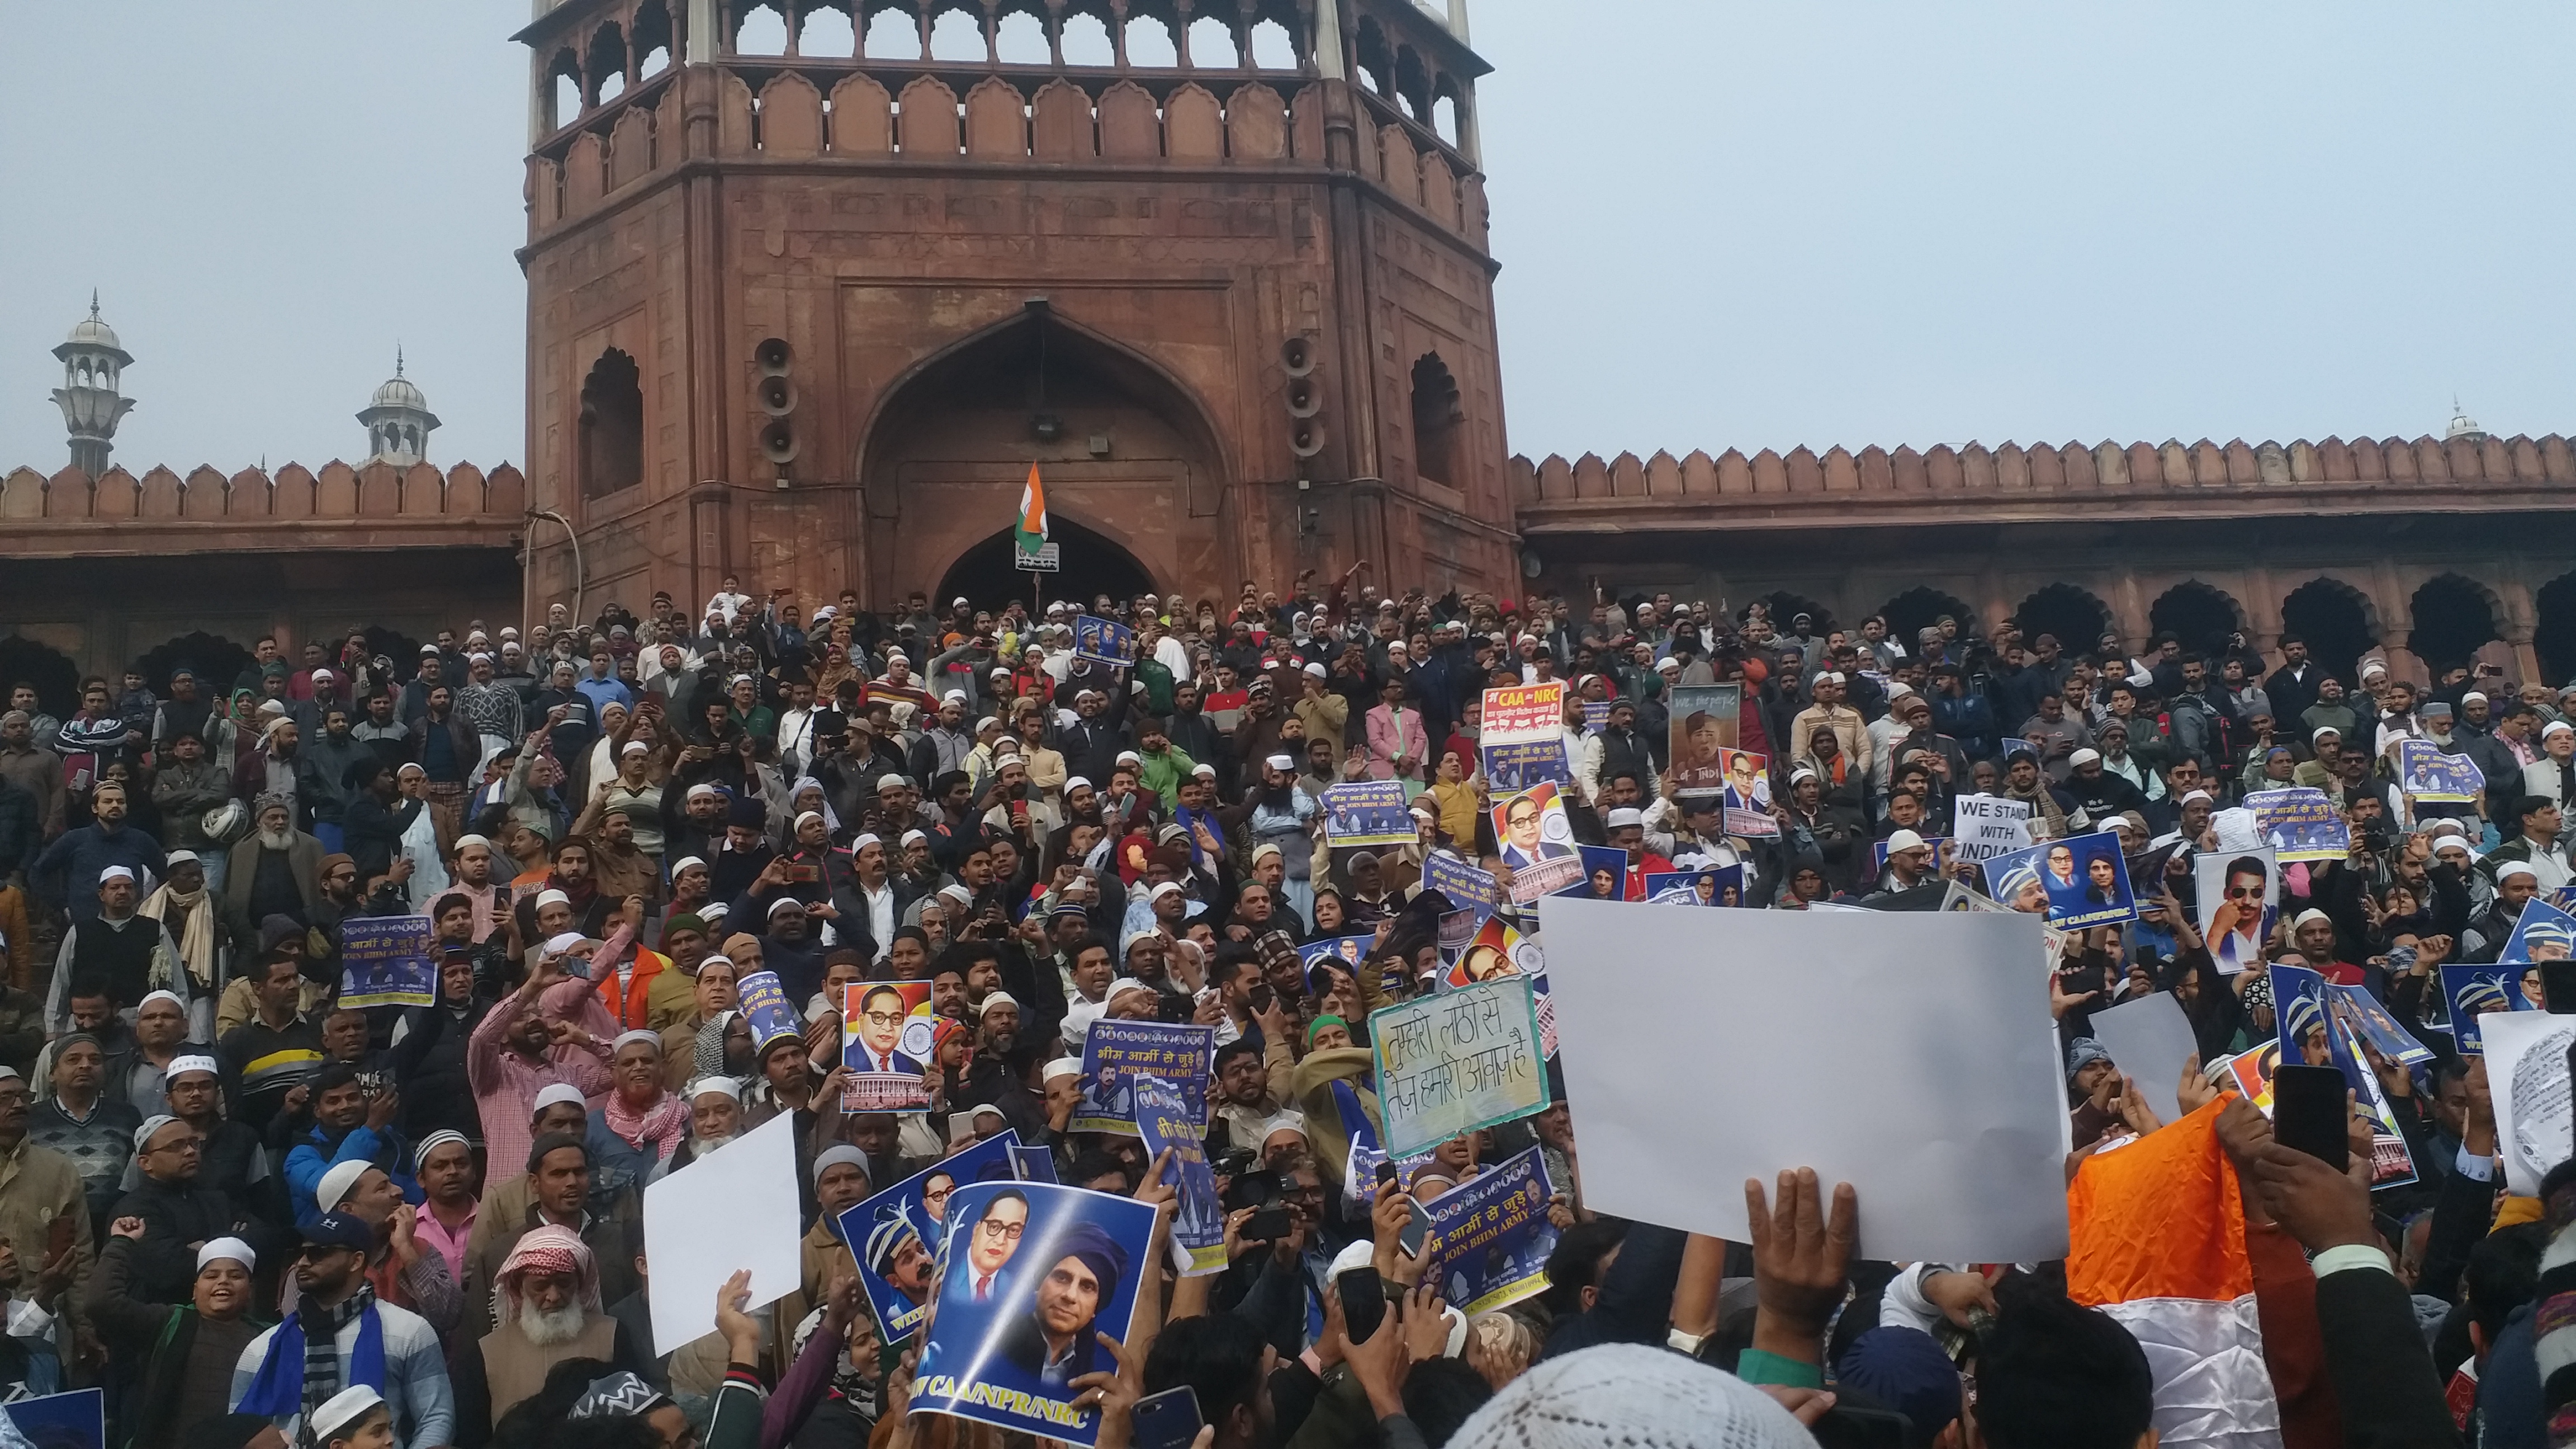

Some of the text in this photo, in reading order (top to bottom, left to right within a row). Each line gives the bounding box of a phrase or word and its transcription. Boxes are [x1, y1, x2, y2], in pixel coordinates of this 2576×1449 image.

[1499, 692, 1524, 707] CAA
[1534, 687, 1559, 704] NRC
[1710, 694, 1735, 709] people
[1680, 767, 1723, 782] of INDI
[1961, 801, 2027, 821] WE STAND
[2275, 804, 2298, 815] आर्मी
[1980, 825, 2015, 840] WITH
[349, 937, 379, 950] आर्मी
[382, 936, 394, 948] से
[389, 948, 413, 956] ARMY
[744, 988, 768, 1008] आर्मी
[745, 997, 781, 1019] OIN BHIM
[1479, 987, 1502, 1036] से
[1097, 1045, 1195, 1068] भीम आर्मी से जुड़े
[1509, 1027, 1527, 1078] है
[1119, 1065, 1141, 1074] JOIN
[1168, 1068, 1194, 1078] ARMY
[1363, 1181, 1379, 1192] JOI
[1448, 1190, 1526, 1242] आर्मी से जुड़े
[1444, 1243, 1469, 1263] JOIN
[1470, 1226, 1499, 1248] BHIM
[1500, 1208, 1530, 1233] ARMY
[929, 1375, 1090, 1429] CAA/NPR/NRC
